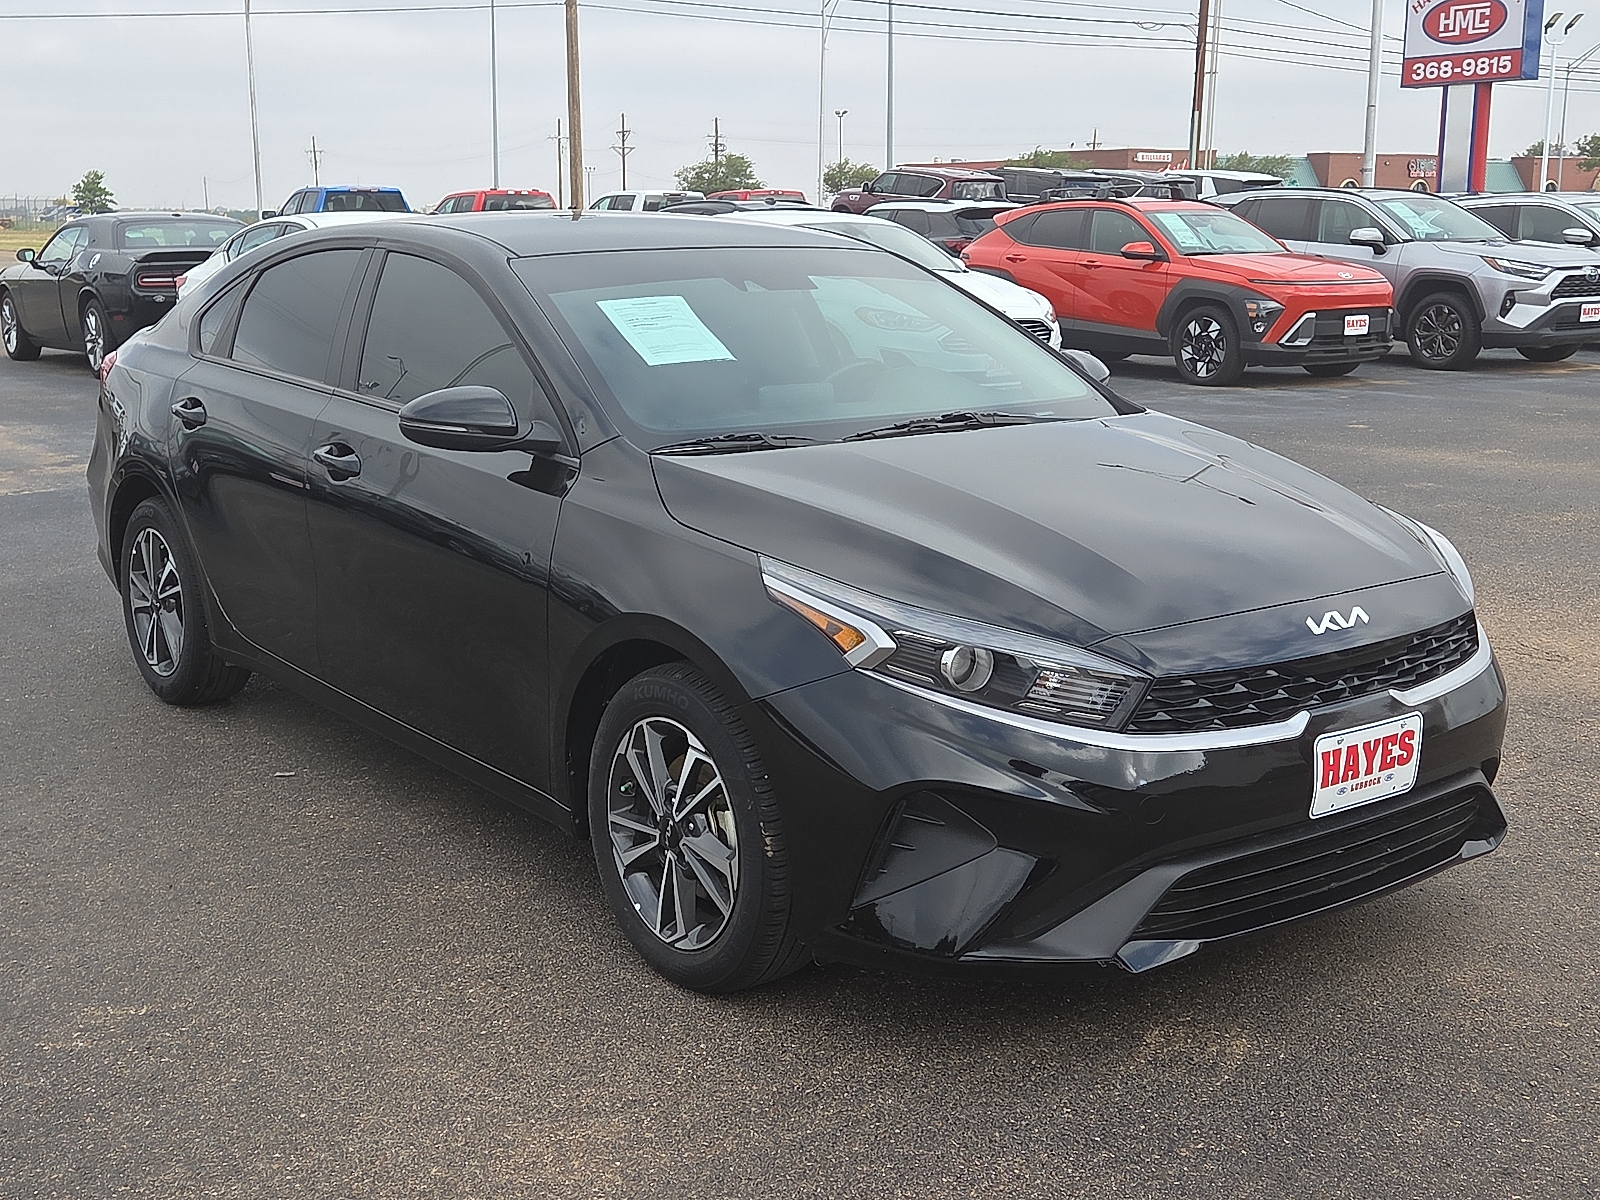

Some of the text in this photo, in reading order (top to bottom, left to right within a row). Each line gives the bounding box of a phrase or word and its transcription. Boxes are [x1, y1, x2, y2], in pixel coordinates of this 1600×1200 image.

[1411, 56, 1512, 81] 368-9815
[1346, 319, 1367, 328] HAYES
[1305, 605, 1370, 636] KIA
[633, 684, 690, 710] KUMHO
[1320, 729, 1416, 790] HAYES
[1350, 776, 1382, 792] LUBBOCK
